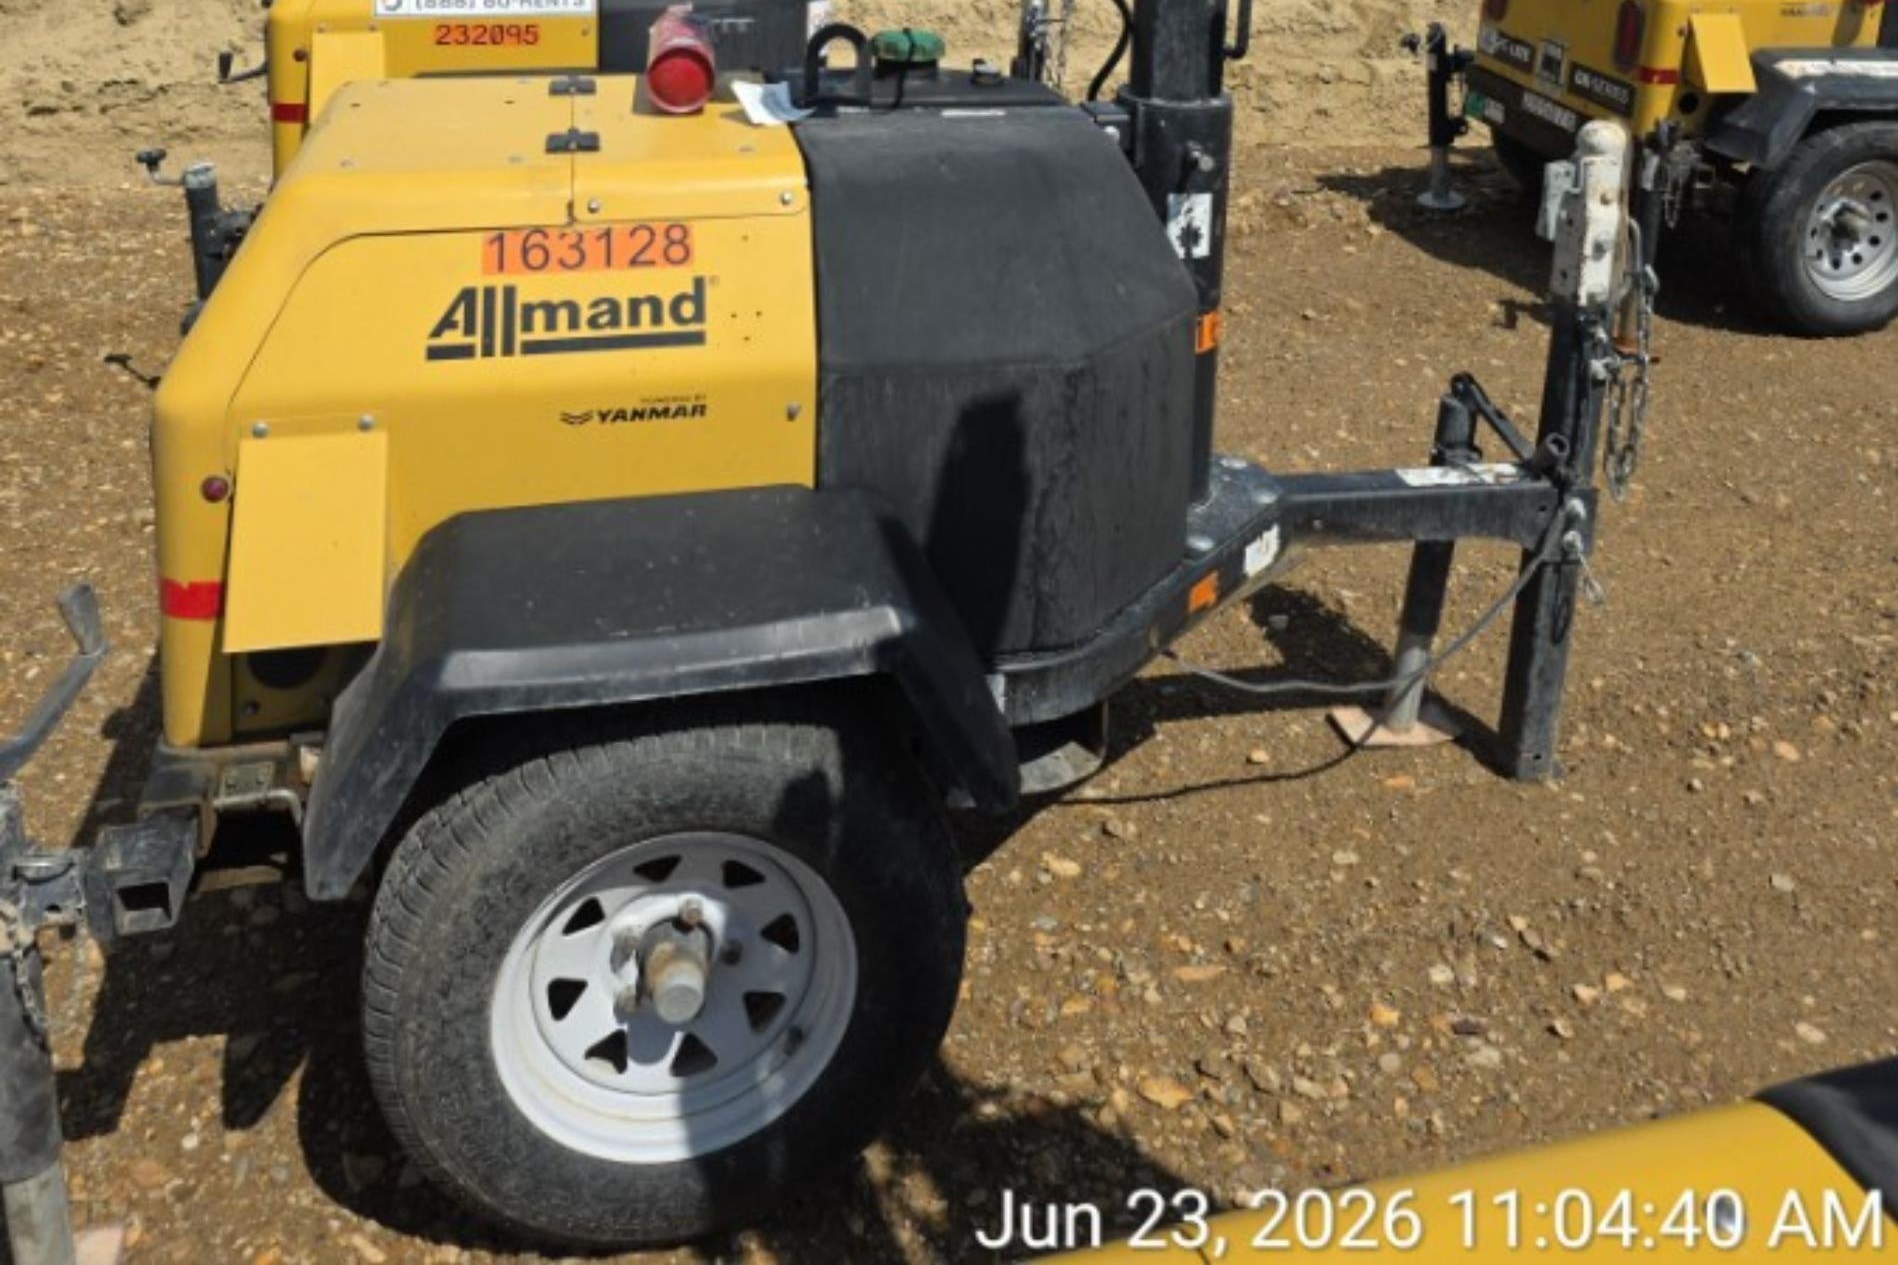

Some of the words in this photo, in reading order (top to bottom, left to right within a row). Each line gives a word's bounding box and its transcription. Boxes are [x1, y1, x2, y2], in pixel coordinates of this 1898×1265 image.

[435, 23, 540, 46] 232095
[487, 222, 691, 273] 163128
[426, 275, 707, 361] Allmand
[596, 403, 707, 425] YANMAR
